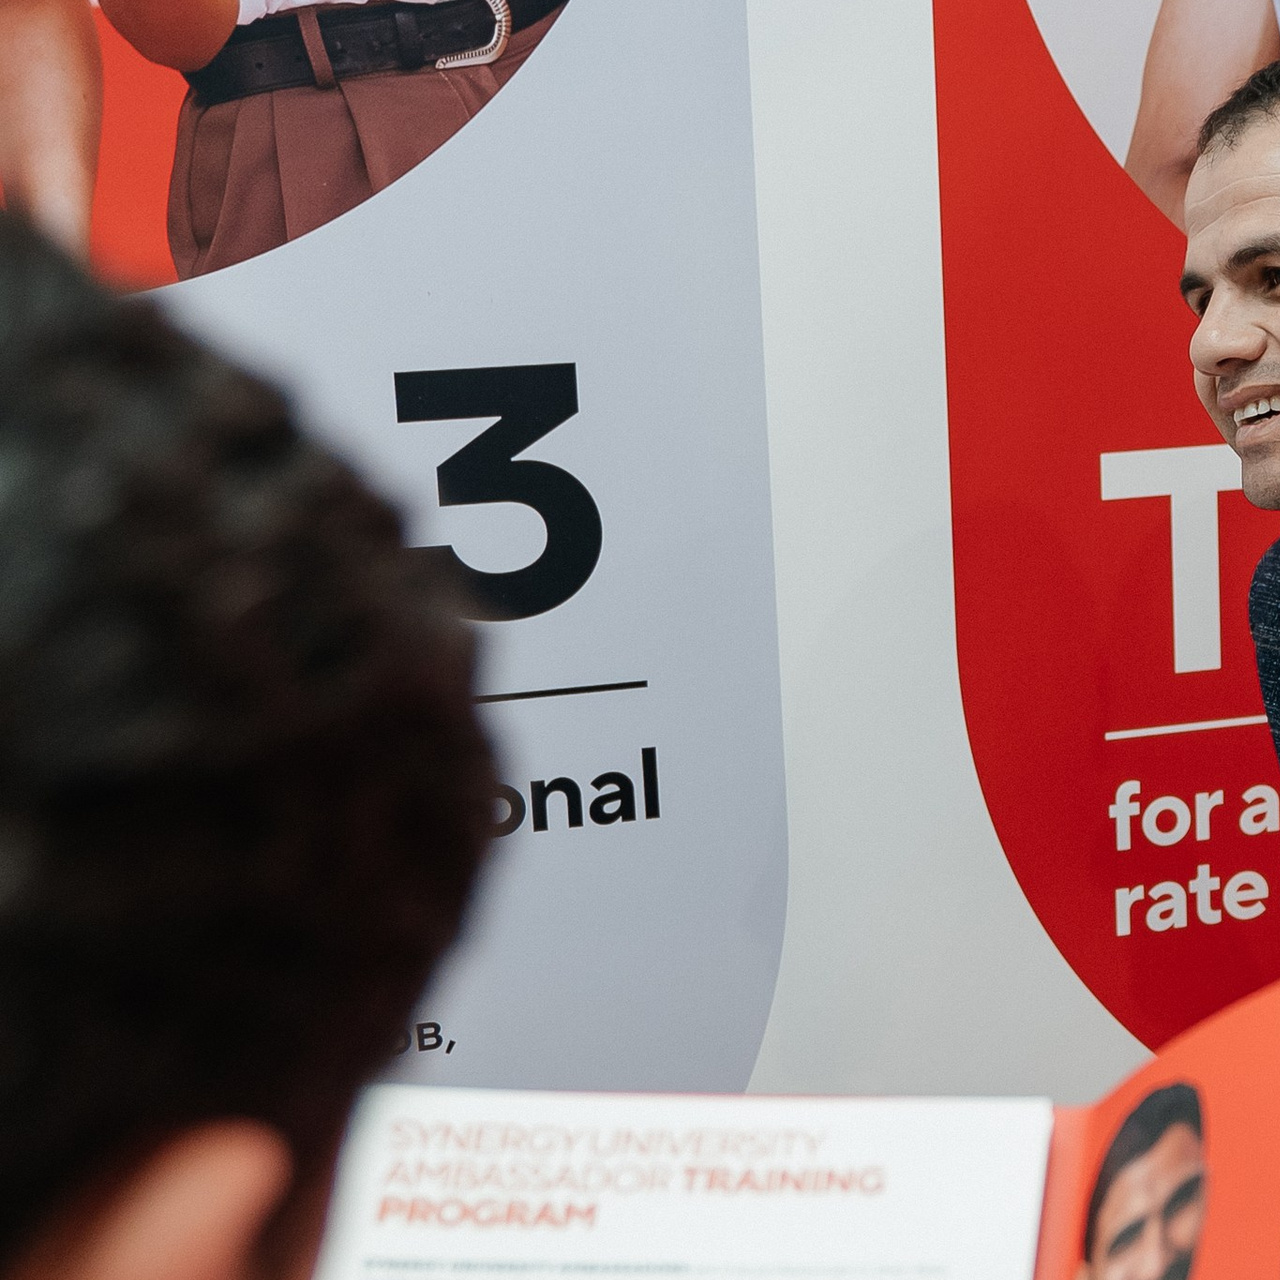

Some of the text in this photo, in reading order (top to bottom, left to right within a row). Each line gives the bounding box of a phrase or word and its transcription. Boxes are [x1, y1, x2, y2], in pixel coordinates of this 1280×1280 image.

[393, 362, 603, 622] 3
[1108, 780, 1223, 852] for
[1115, 864, 1269, 937] rate
[375, 1195, 598, 1229] PROGRAM
[682, 1164, 886, 1198] TRAINING
